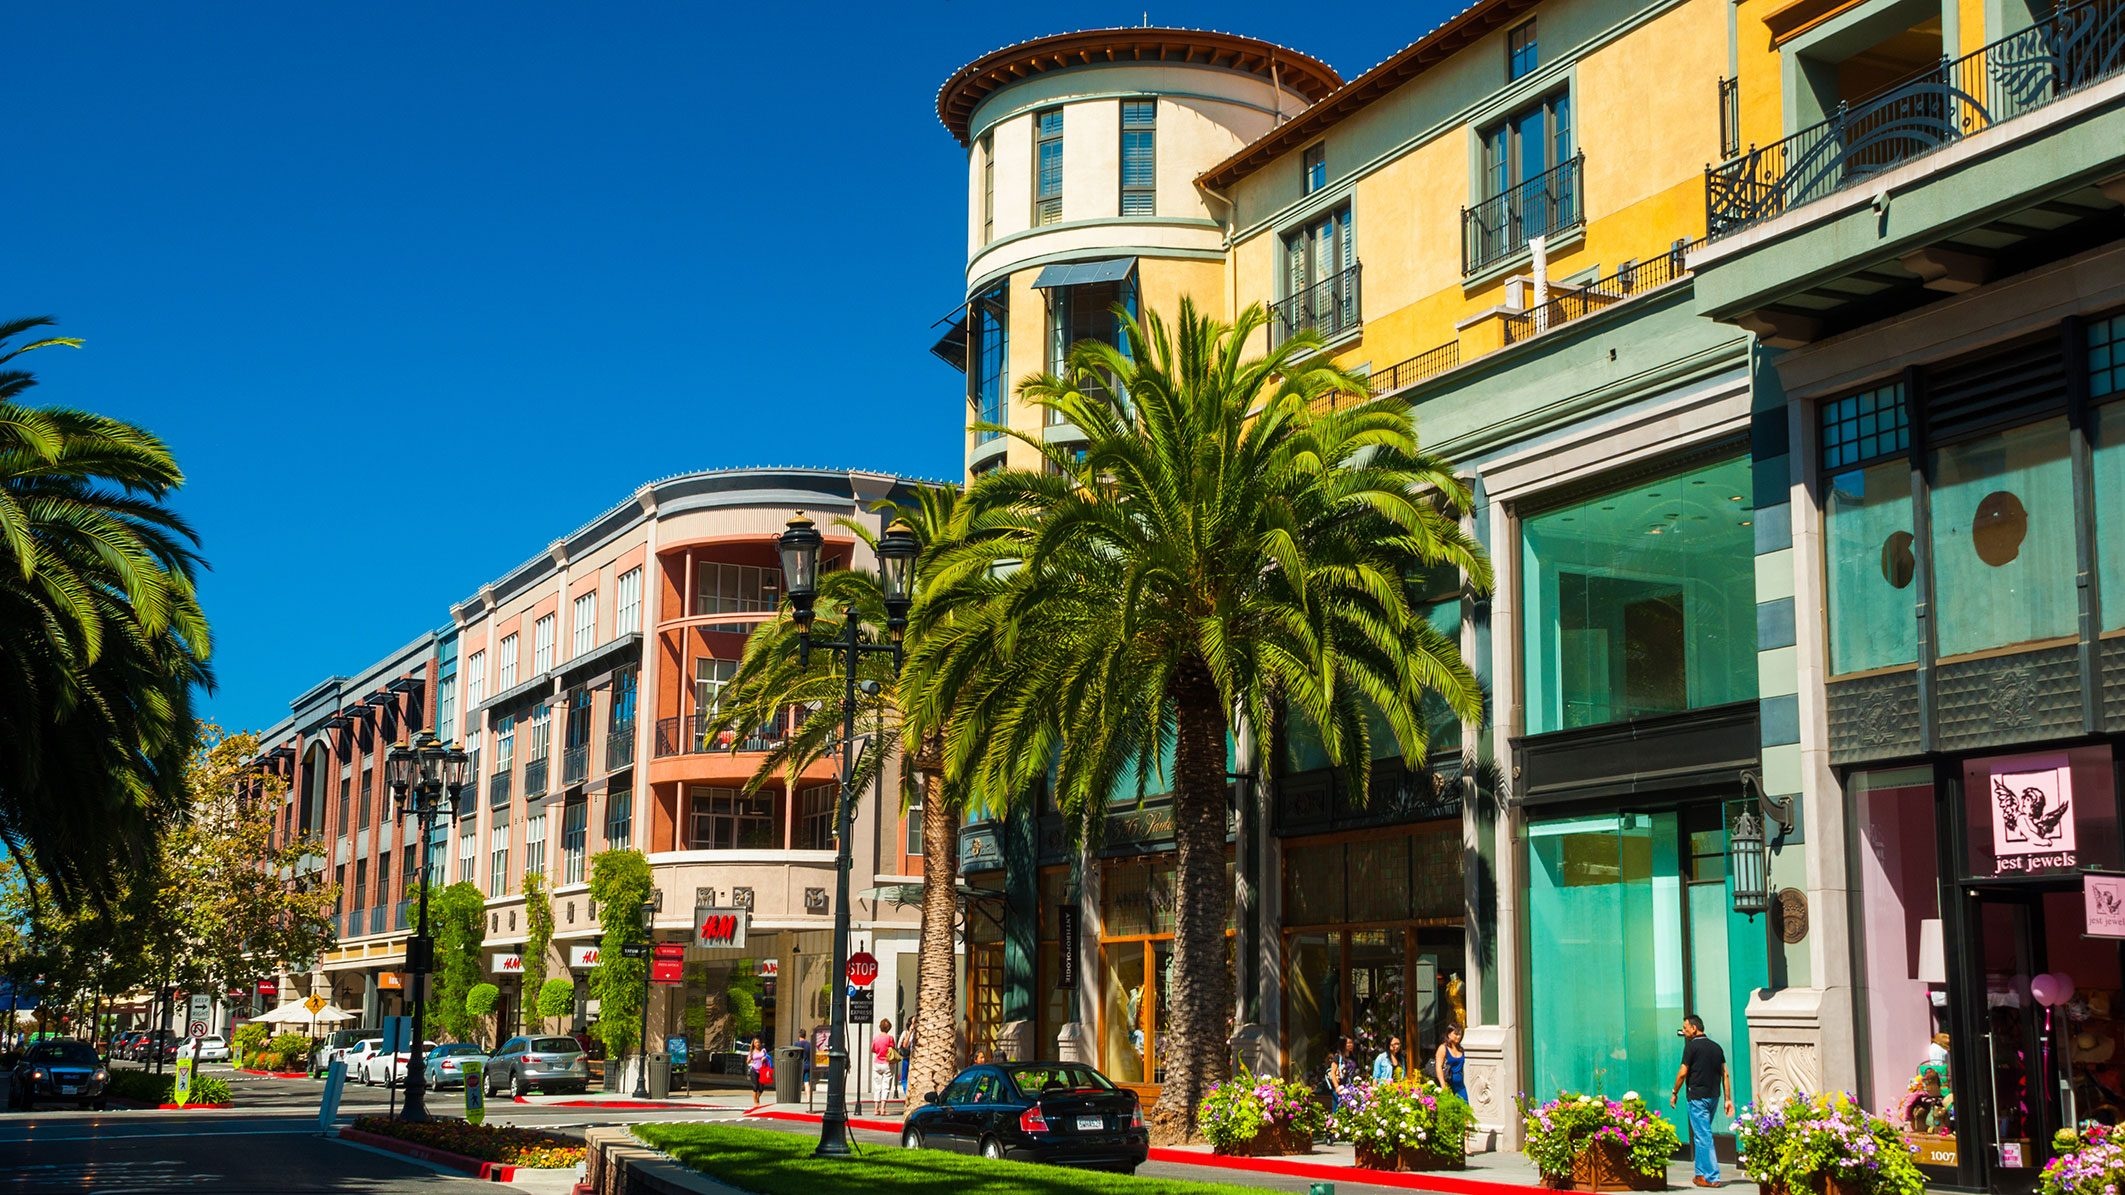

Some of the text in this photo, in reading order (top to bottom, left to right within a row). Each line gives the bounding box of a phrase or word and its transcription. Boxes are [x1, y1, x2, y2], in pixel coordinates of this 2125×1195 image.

[1995, 851, 2077, 874] jest jewels
[700, 914, 737, 940] H&M
[2088, 917, 2125, 927] jest jewel
[848, 962, 877, 976] STOP
[848, 986, 854, 995] P
[1930, 1150, 1956, 1163] 1007
